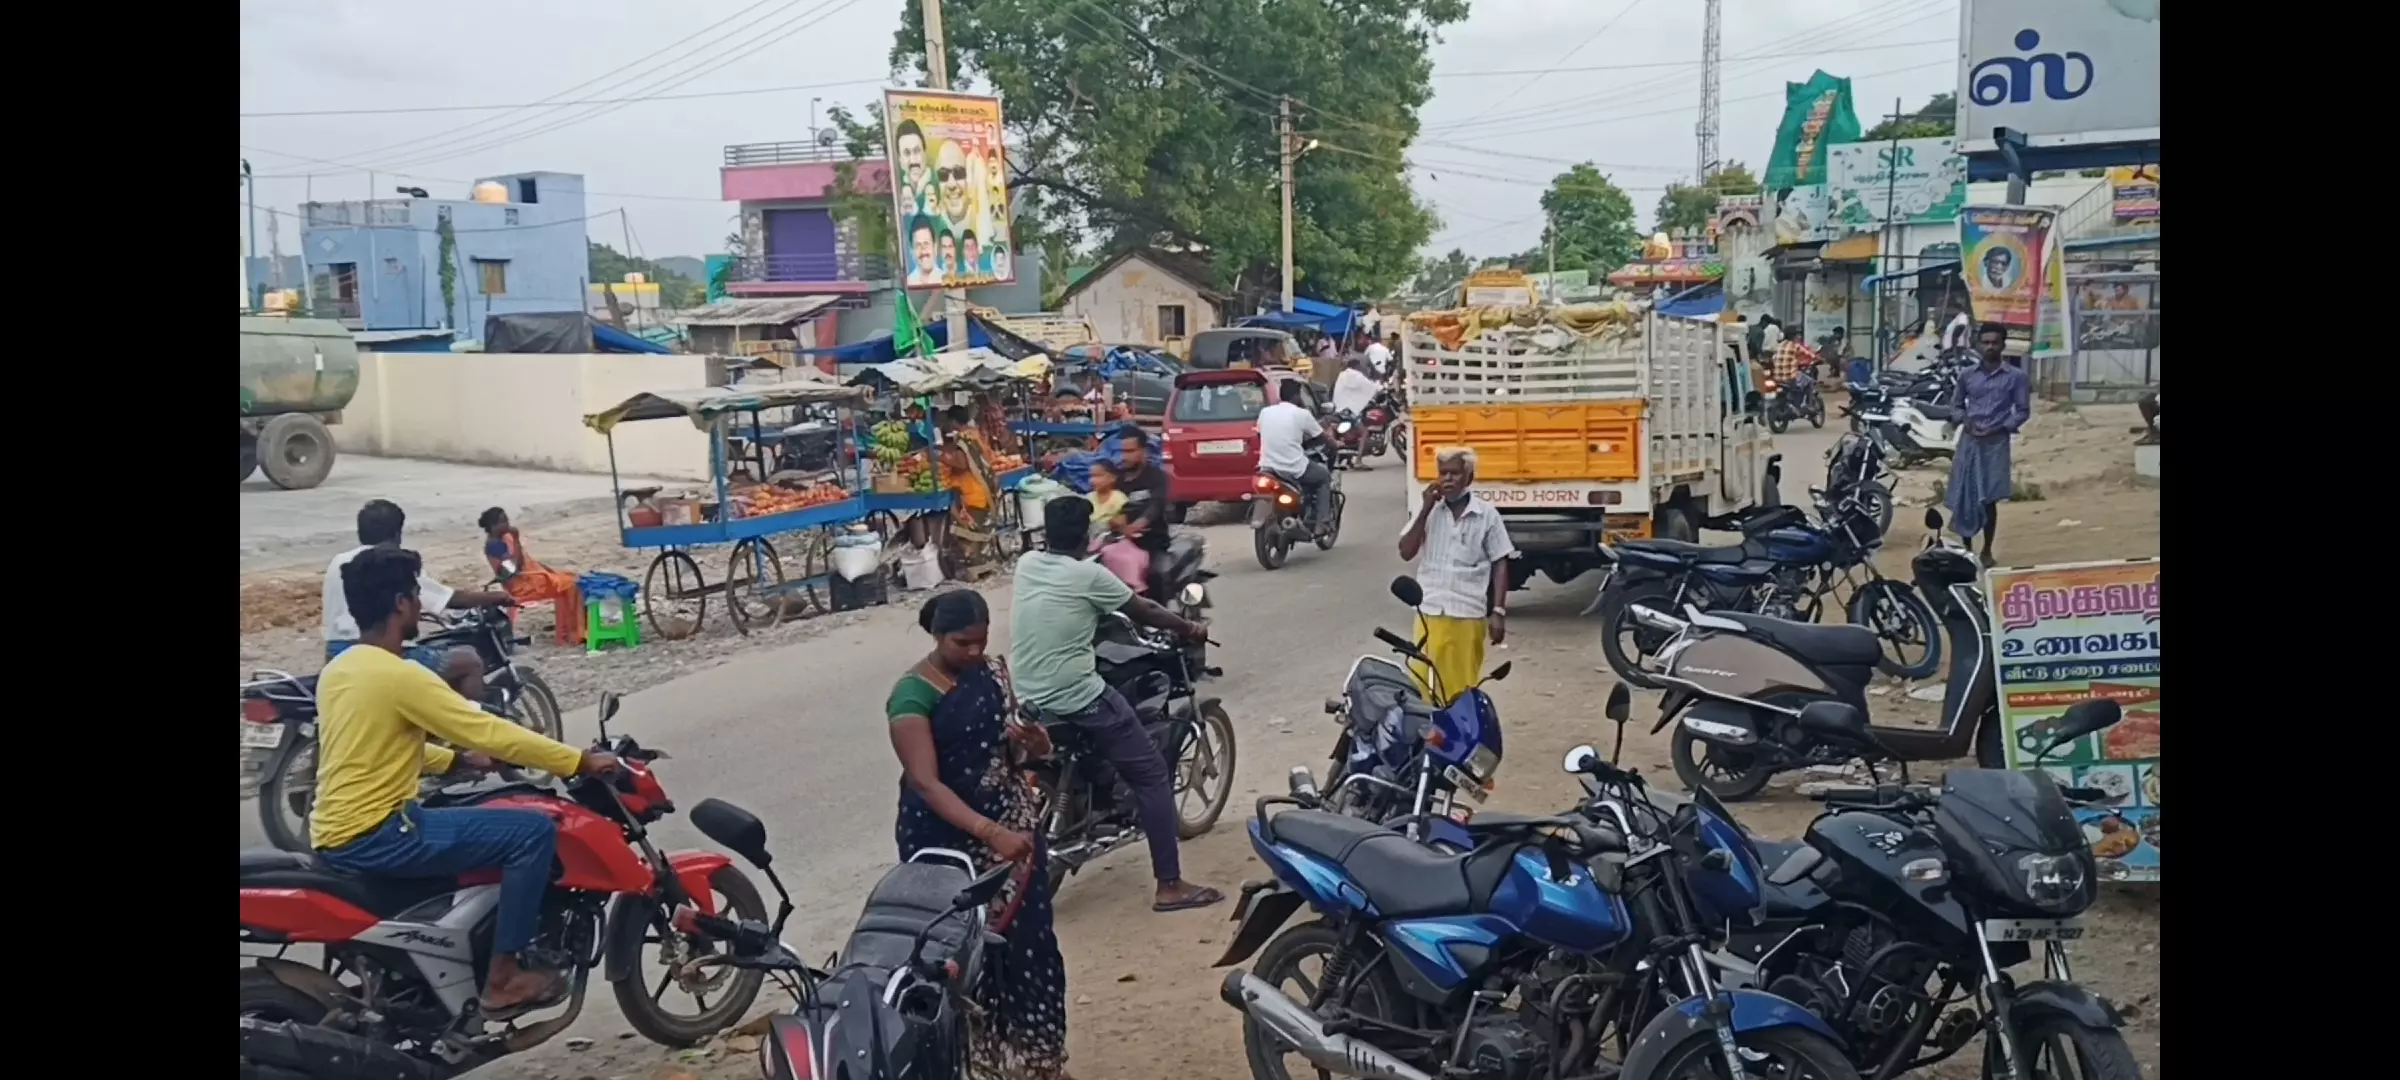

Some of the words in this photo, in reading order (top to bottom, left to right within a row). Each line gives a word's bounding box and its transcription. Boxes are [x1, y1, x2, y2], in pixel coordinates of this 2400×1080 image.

[1968, 29, 2094, 106] ஸ்
[1877, 146, 1915, 169] SR
[1532, 490, 1580, 502] HORN
[2052, 663, 2104, 680] முறை
